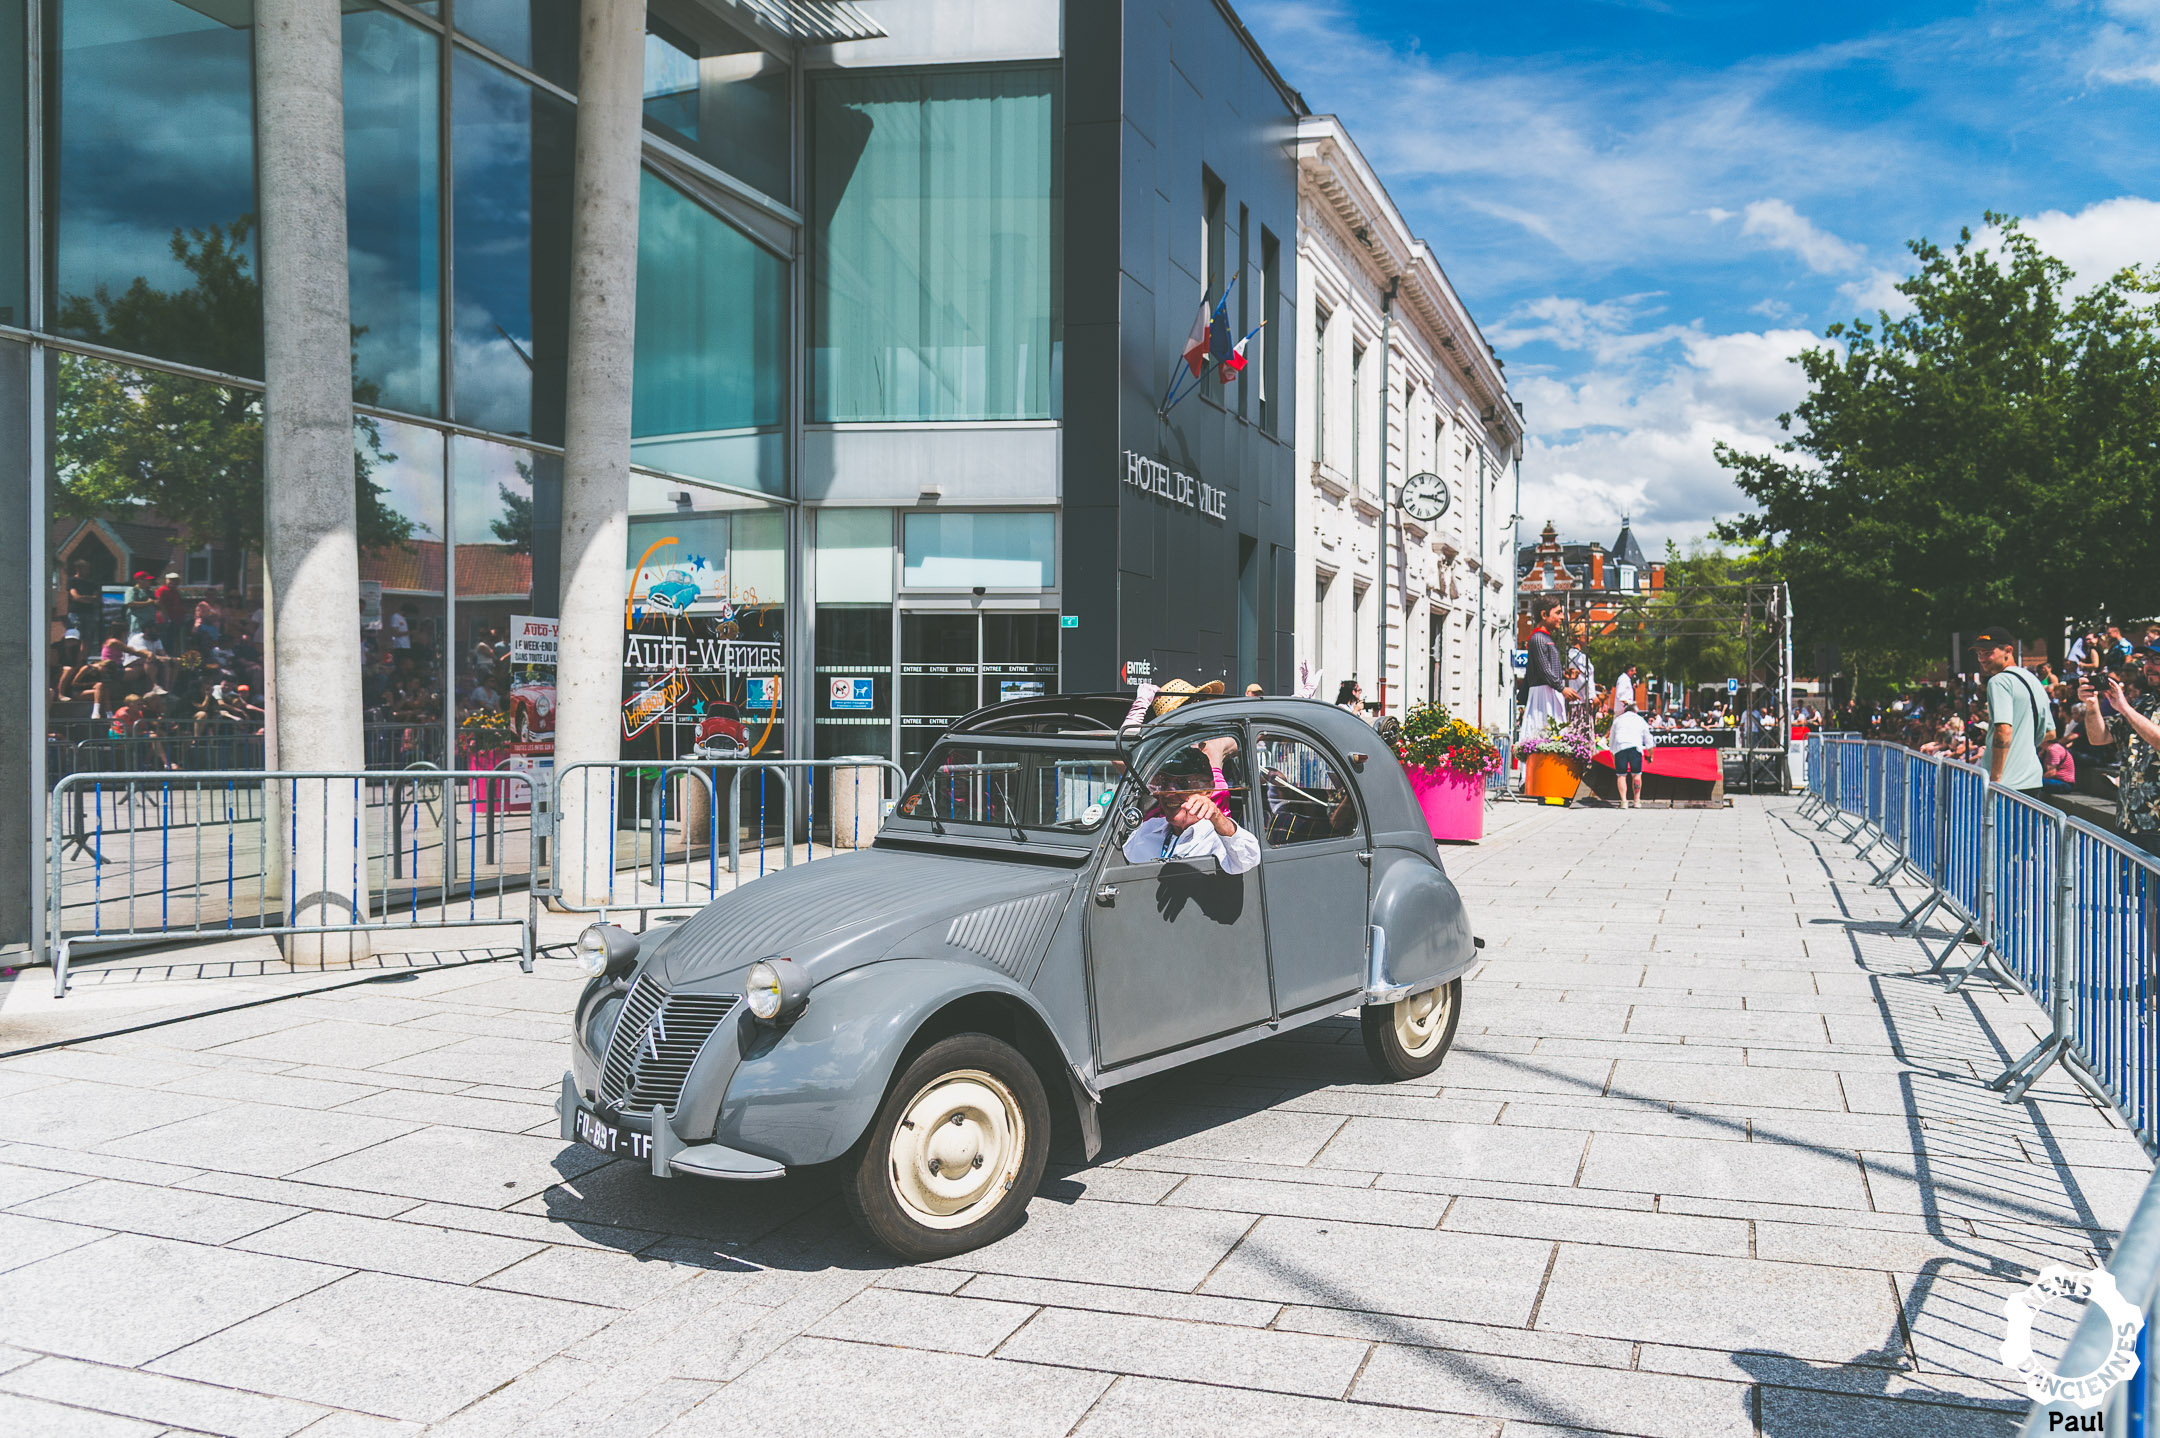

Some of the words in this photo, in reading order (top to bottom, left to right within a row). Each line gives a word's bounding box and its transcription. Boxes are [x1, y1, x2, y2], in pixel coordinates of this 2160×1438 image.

[1126, 450, 1174, 499] HOTEL
[1176, 472, 1194, 507] DE
[1196, 481, 1227, 520] VILLE
[523, 640, 552, 651] WEEK-END
[624, 634, 781, 677] Auto-Weppes
[1126, 658, 1151, 675] ENTRÉE
[1653, 733, 1680, 745] ptic
[1680, 733, 1714, 745] 2000
